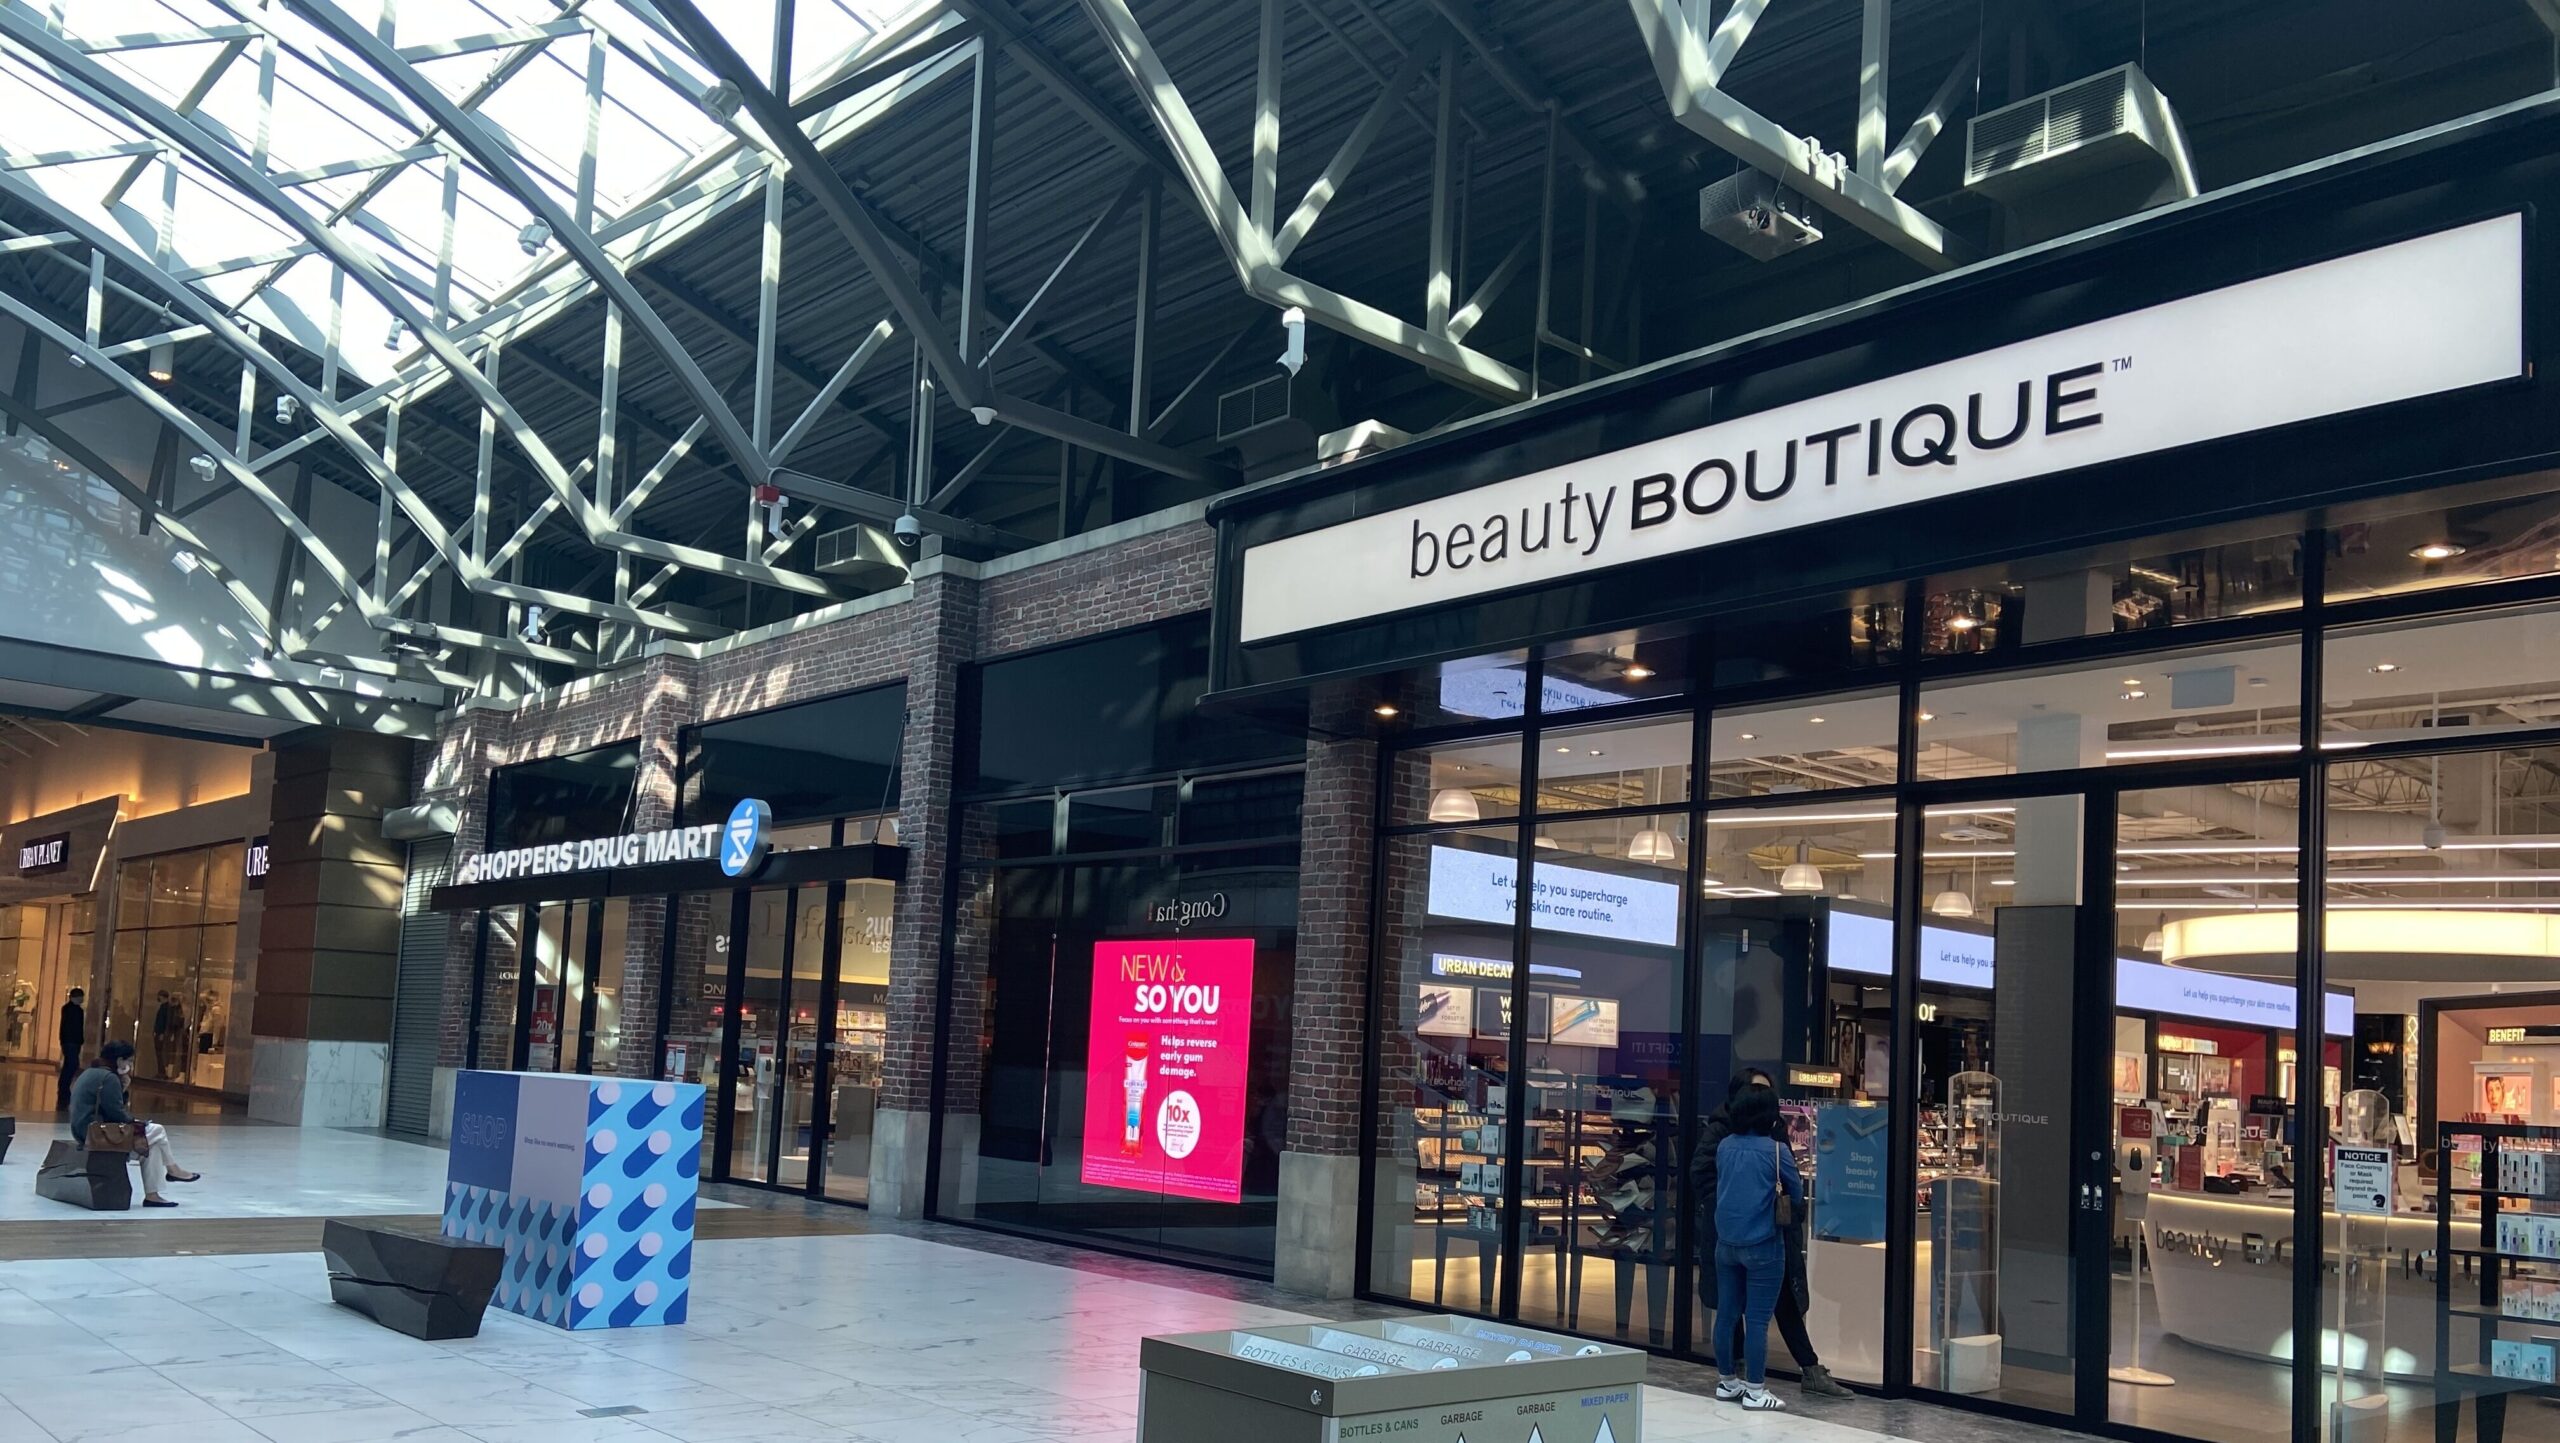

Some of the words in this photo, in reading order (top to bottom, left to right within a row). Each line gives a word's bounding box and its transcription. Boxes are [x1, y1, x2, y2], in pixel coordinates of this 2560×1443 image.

[1410, 481, 1617, 579] beauty
[1631, 361, 2105, 530] BOUTIQUE
[19, 845, 38, 868] URBAN
[38, 840, 63, 865] PLANET
[468, 842, 573, 881] SHOPPERS
[578, 833, 639, 869] DRUG
[645, 824, 718, 863] MART
[1492, 872, 1508, 887] Let
[1532, 879, 1546, 896] elp
[1549, 885, 1567, 897] you
[1570, 887, 1628, 907] supercharge
[1531, 900, 1551, 914] skin
[1554, 905, 1575, 917] care
[1577, 908, 1613, 922] routine.
[1940, 950, 1951, 961] Let
[1952, 954, 1960, 963] us
[1962, 953, 1975, 968] help
[1977, 959, 1988, 968] you
[1121, 954, 1169, 982] NEW
[1171, 954, 1185, 983] &
[1438, 958, 1479, 975] URBAN
[1479, 962, 1514, 979] DECAY
[1134, 984, 1167, 1013] SO
[1168, 984, 1220, 1014] YOU
[1161, 1035, 1185, 1048] Helps
[1186, 1039, 1218, 1048] reverse
[2489, 1028, 2526, 1043] BENEFIT
[1160, 1050, 1182, 1063] early
[1183, 1054, 1203, 1064] gum
[1159, 1064, 1196, 1079] damage.
[1798, 1073, 1817, 1083] URBAN
[1167, 1105, 1190, 1123] 10x
[1850, 1151, 1873, 1165] Shop
[2344, 1151, 2381, 1162] NOTICE
[1845, 1165, 1878, 1179] beauty
[2355, 1163, 2383, 1172] Covering
[1847, 1180, 1875, 1191] online
[2155, 1220, 2228, 1268] beauty
[1342, 1343, 1407, 1366] GARBAGE
[1416, 1337, 1481, 1359] GARBAGE
[1242, 1345, 1299, 1368] BOTTLES
[1299, 1359, 1310, 1370] &
[1313, 1361, 1350, 1379] CANS
[1516, 1401, 1556, 1416] GARBAGE
[1580, 1395, 1604, 1408] MIXED
[1605, 1392, 1629, 1405] PAPER
[1440, 1410, 1483, 1425] GARBAGE
[1340, 1422, 1383, 1438] BOTTLES
[1385, 1422, 1392, 1433] &
[1394, 1418, 1419, 1431] CANS
